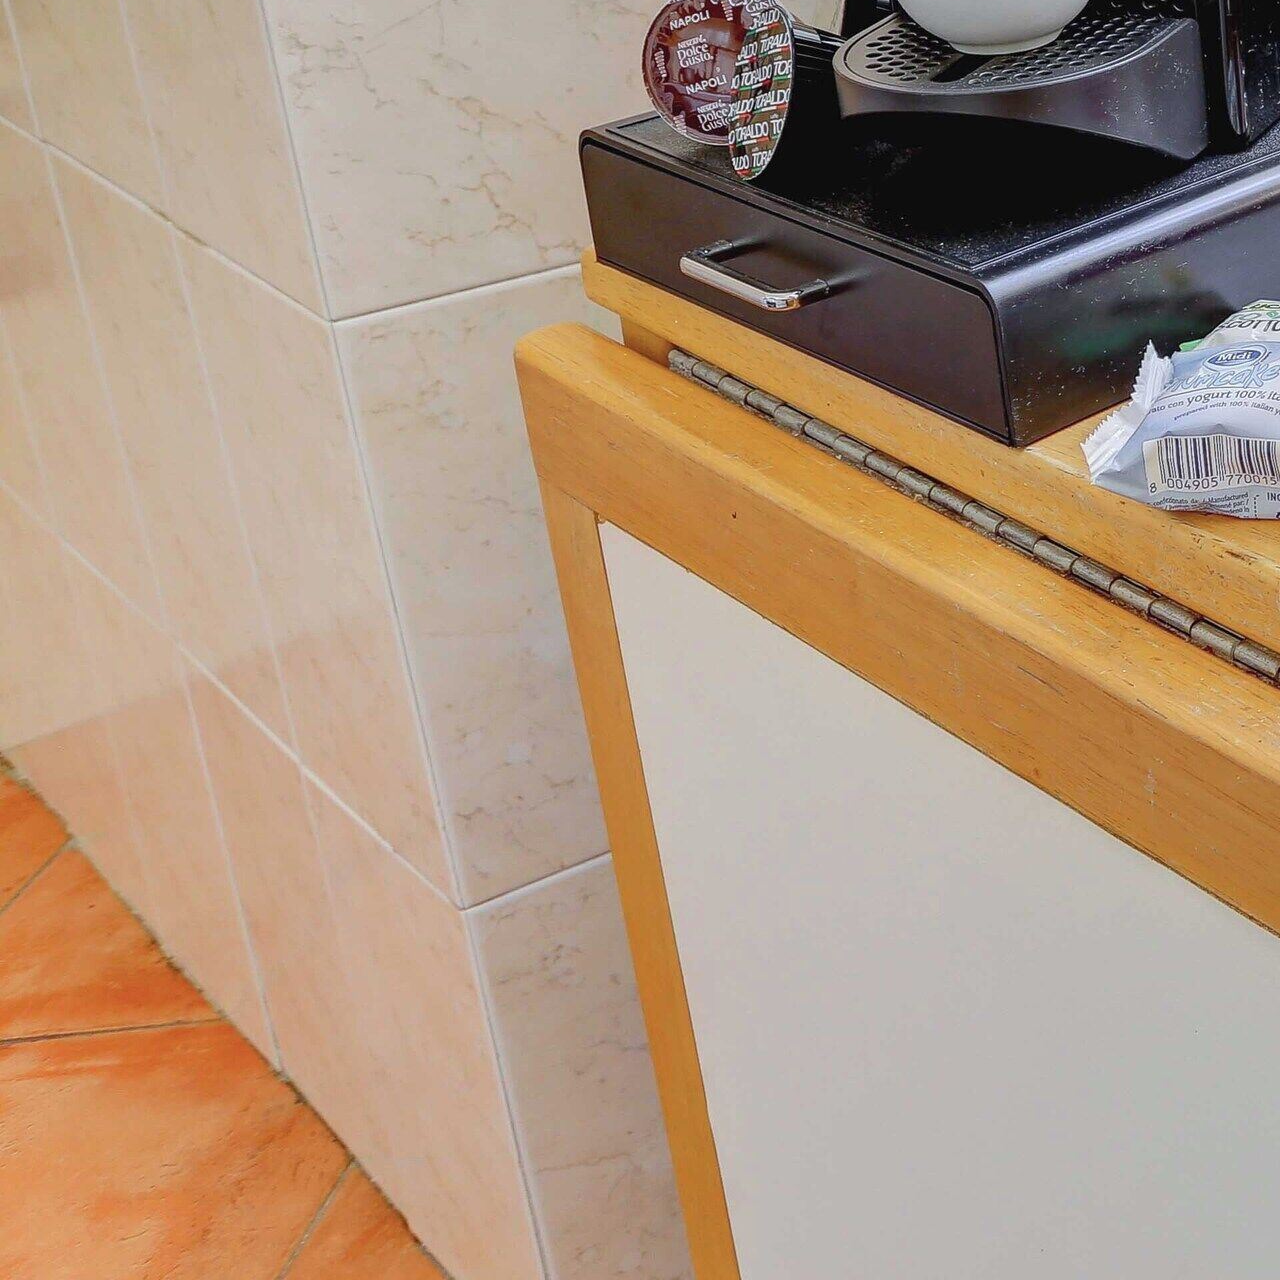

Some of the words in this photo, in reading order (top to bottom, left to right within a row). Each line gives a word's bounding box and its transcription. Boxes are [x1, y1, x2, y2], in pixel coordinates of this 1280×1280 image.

[669, 10, 710, 31] NAPOLI
[677, 44, 709, 61] Dolce
[685, 75, 727, 95] NAPOLI
[734, 120, 769, 141] TORALDO
[1218, 350, 1253, 362] Midi
[1168, 401, 1184, 409] con
[1187, 390, 1232, 408] yogurt
[1235, 389, 1266, 400] 100%
[1149, 483, 1157, 494] 8
[1167, 476, 1219, 490] 004905
[1225, 474, 1278, 487] 770015
